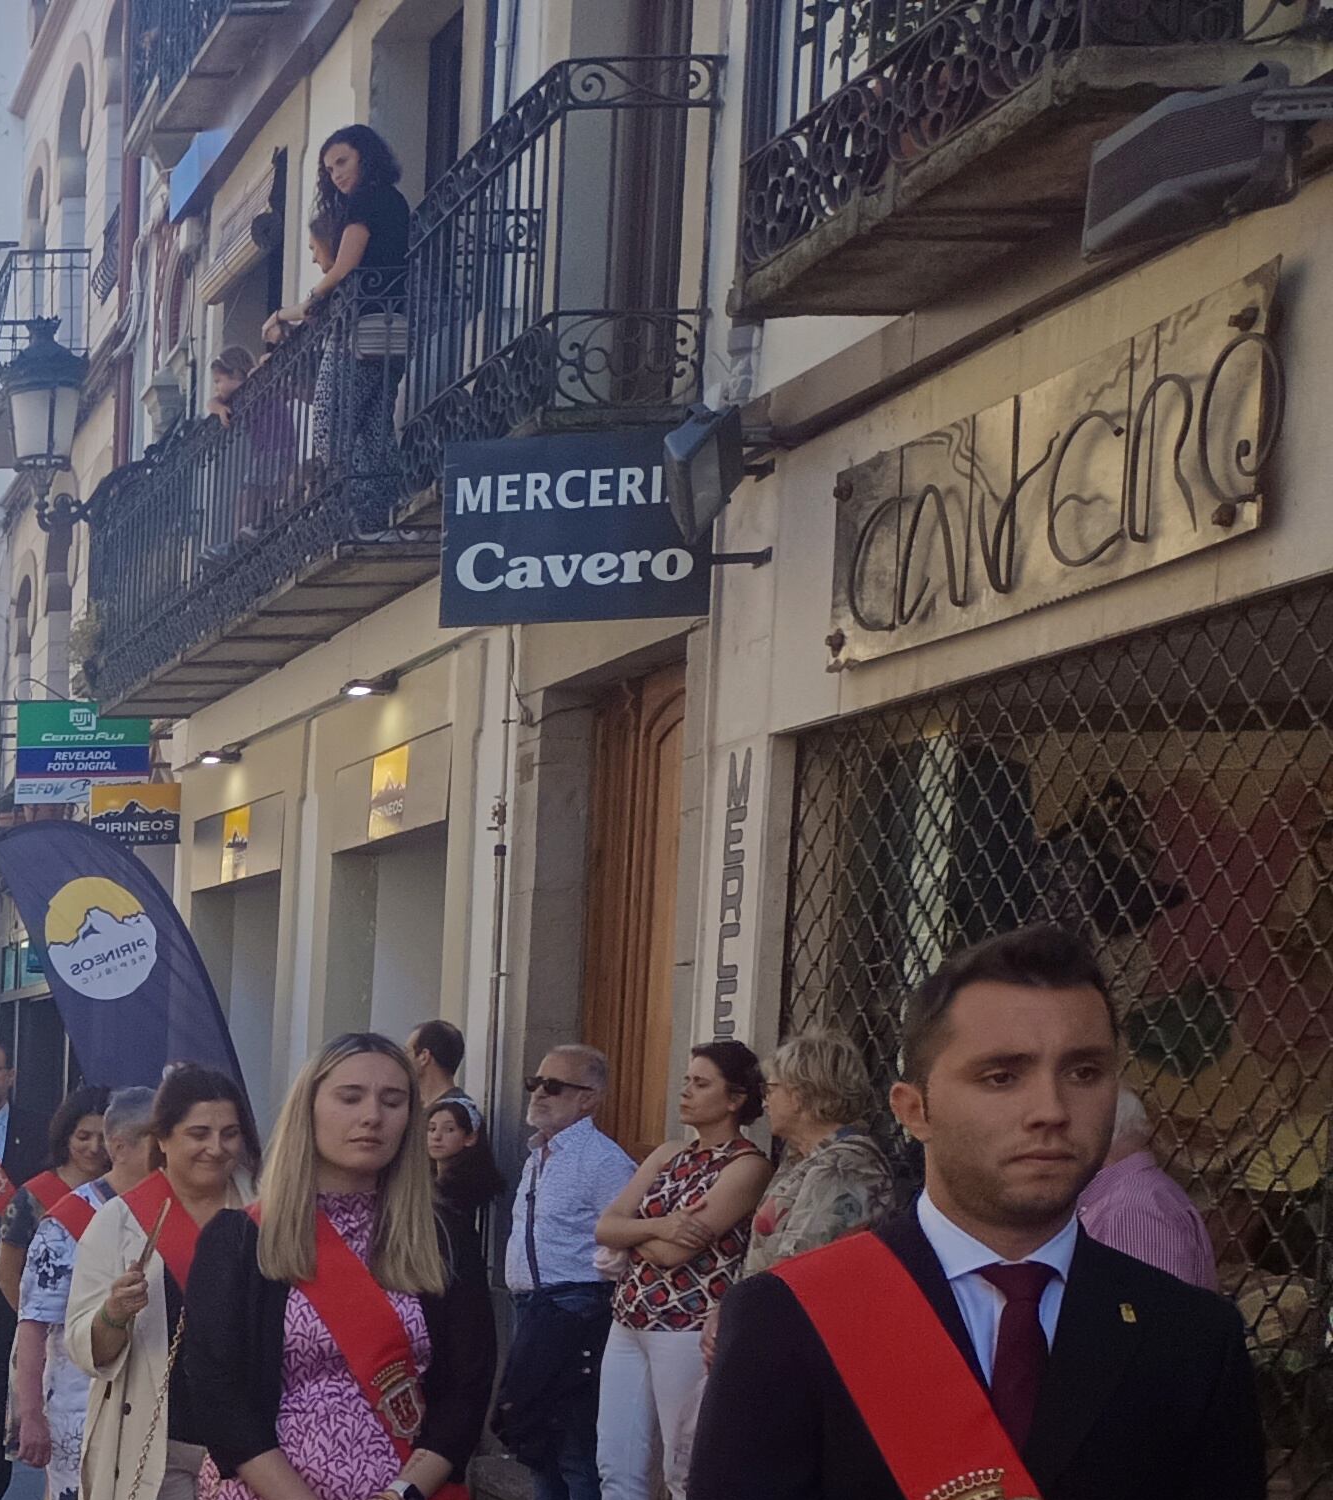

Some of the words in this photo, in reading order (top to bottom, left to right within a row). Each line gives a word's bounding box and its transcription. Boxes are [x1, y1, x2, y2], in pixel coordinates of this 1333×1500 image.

[456, 465, 671, 515] MERCERI
[456, 542, 694, 592] Cavero
[46, 762, 74, 772] FOTO
[76, 761, 117, 771] DIGITAL
[54, 751, 111, 761] REVELADO
[113, 833, 168, 841] PUBLIC
[713, 747, 752, 1043] MERCE
